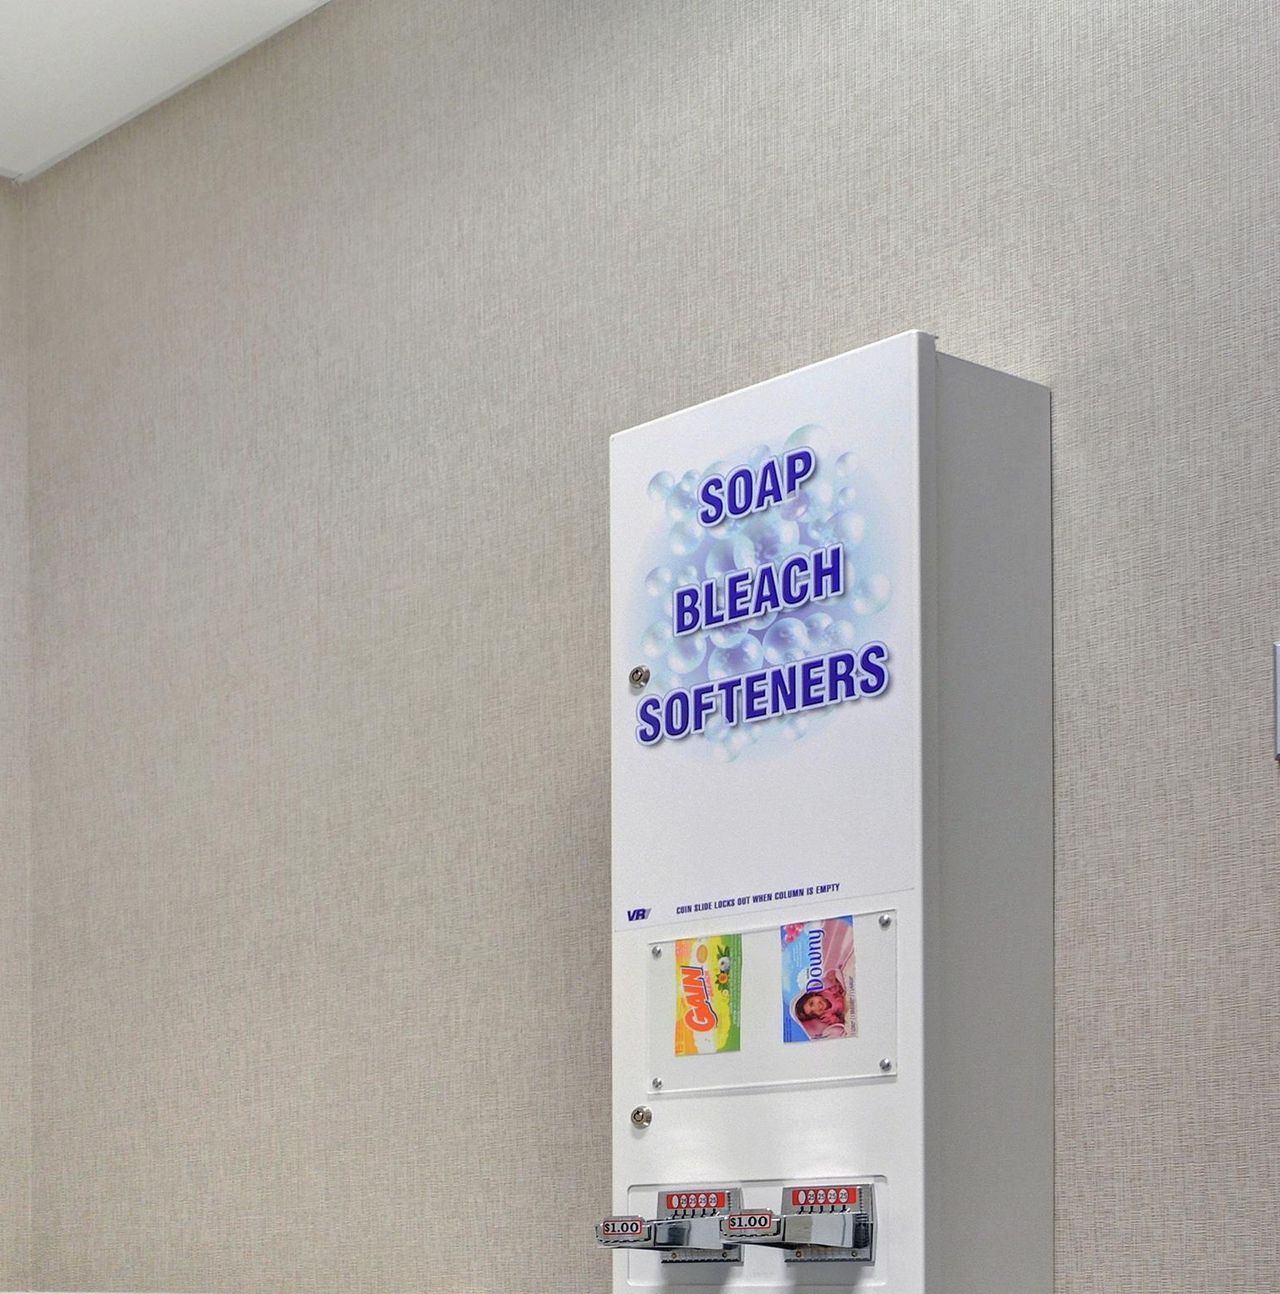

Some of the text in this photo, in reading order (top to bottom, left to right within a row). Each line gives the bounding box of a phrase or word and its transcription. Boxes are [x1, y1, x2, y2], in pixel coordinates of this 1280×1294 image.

[699, 449, 813, 524] SOAP
[674, 546, 842, 634] BLEACH
[637, 644, 886, 743] SOFTENERS
[676, 883, 840, 914] COIN SLIDE LOCKS OUT WHEN COLUMN IS EMPTY
[806, 928, 825, 993] Downy
[681, 966, 717, 1032] GAIN
[604, 1222, 639, 1234] $1.00
[730, 1216, 768, 1228] $1.00
